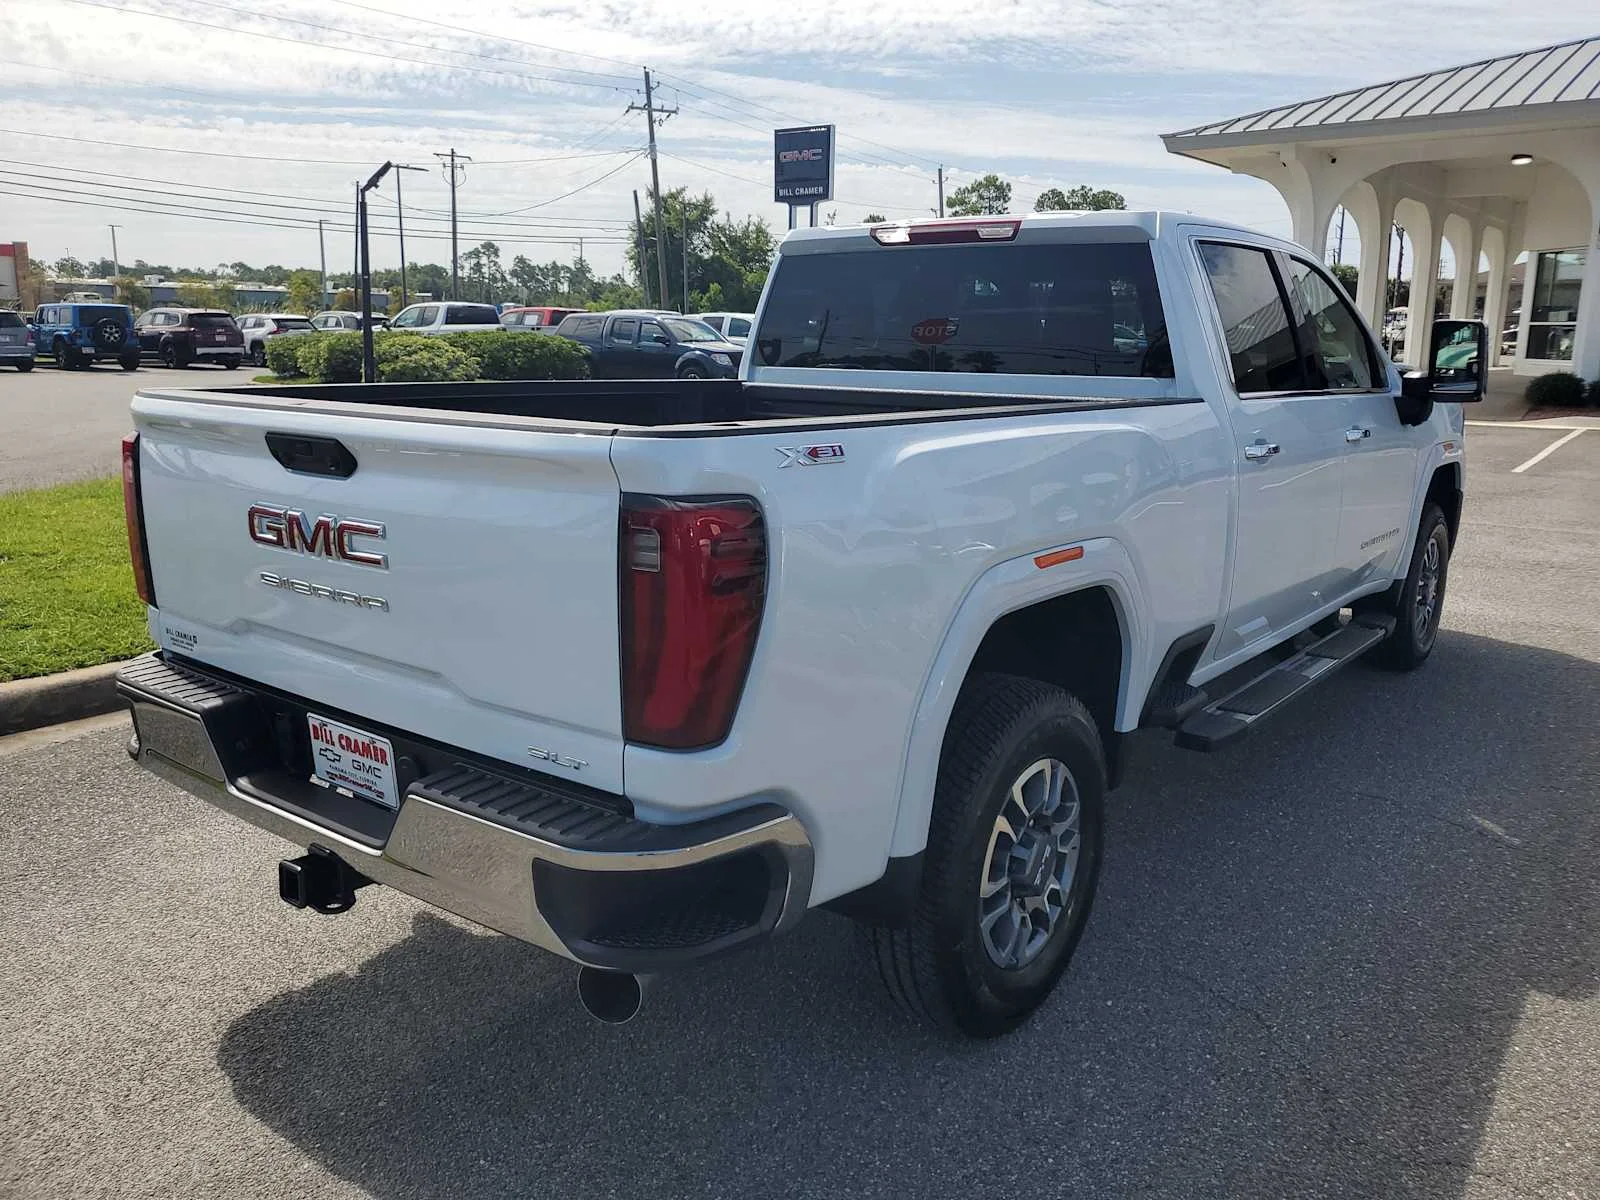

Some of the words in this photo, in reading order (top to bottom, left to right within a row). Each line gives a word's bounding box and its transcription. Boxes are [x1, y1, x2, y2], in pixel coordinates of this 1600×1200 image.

[779, 149, 823, 162] GMC
[778, 188, 793, 196] BILL
[795, 186, 824, 195] CRAMER
[248, 501, 390, 573] GMC
[259, 571, 389, 612] SIERRA
[311, 723, 335, 747] BILL
[338, 733, 389, 766] CRAMER
[352, 759, 382, 779] GMC
[527, 745, 589, 769] SLT
